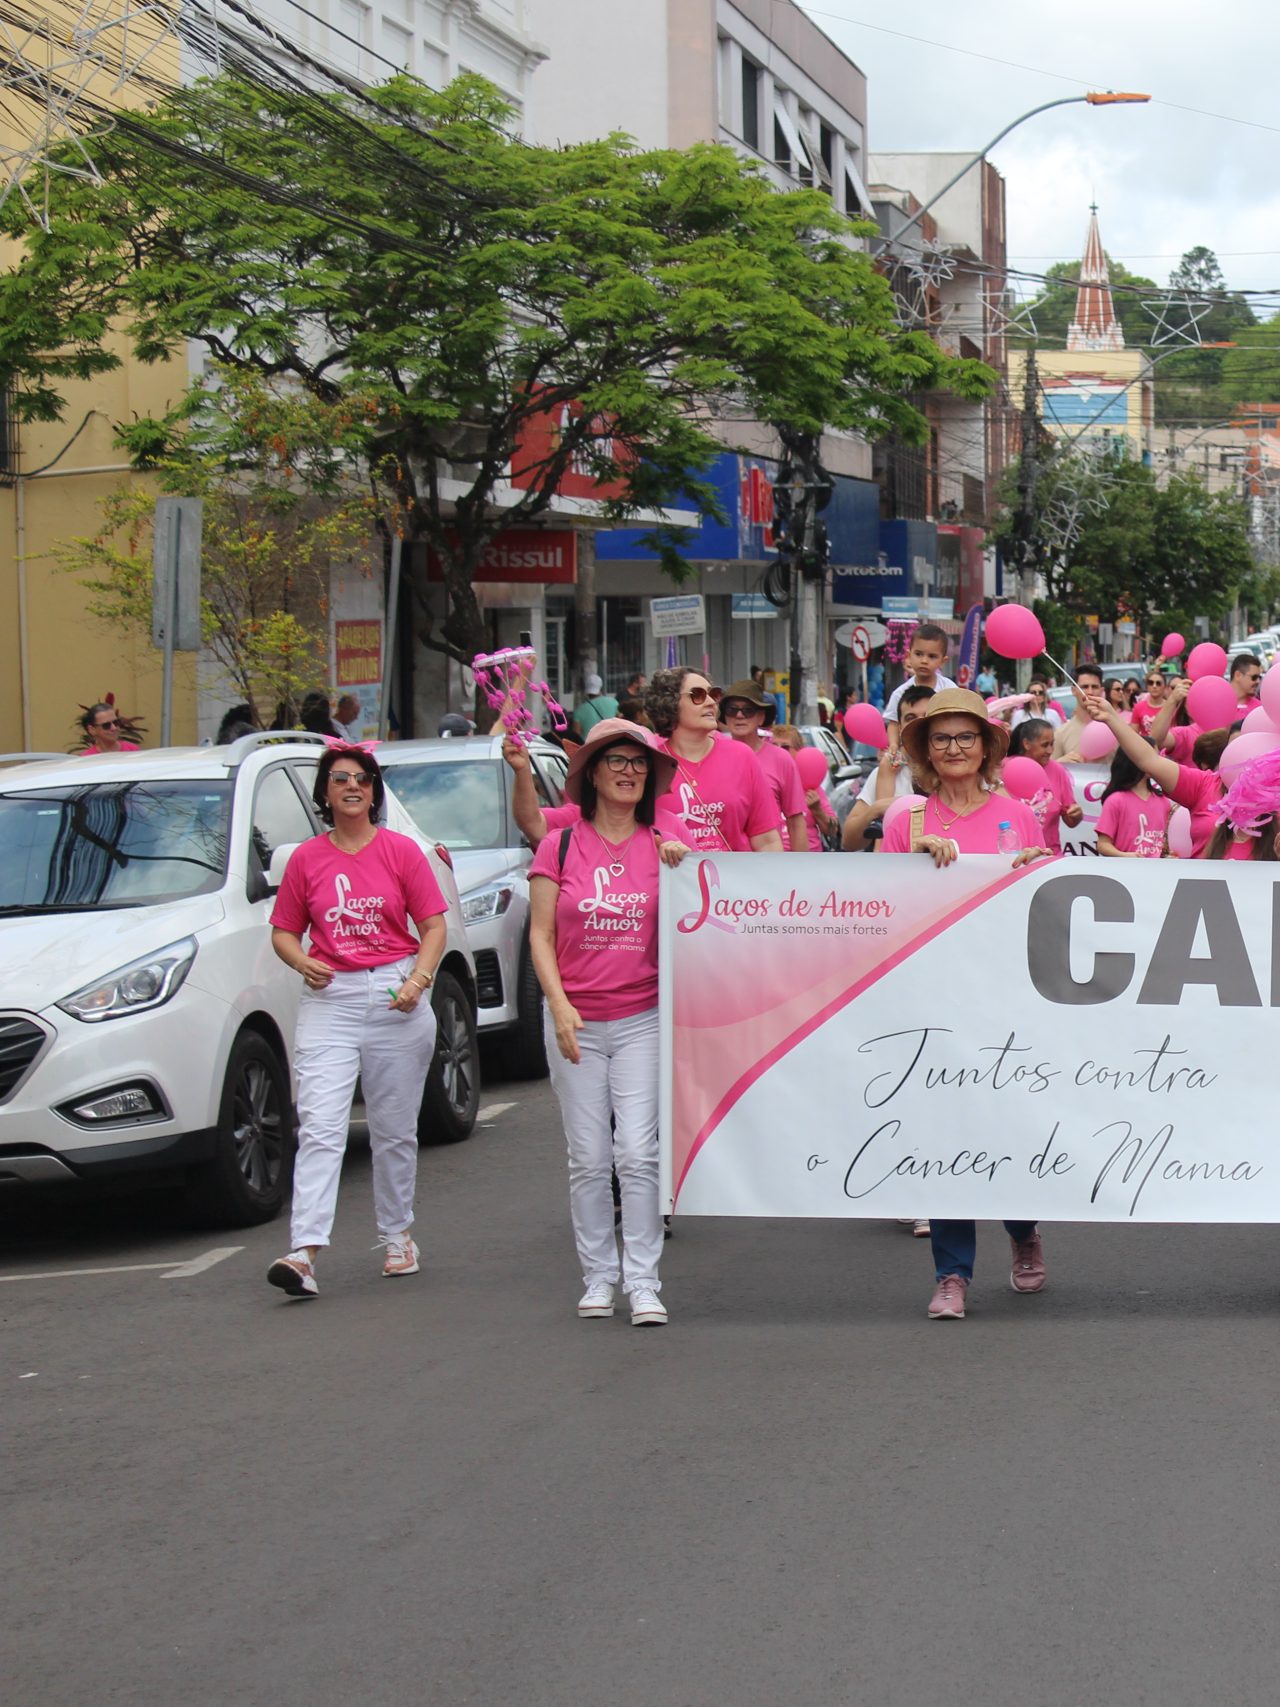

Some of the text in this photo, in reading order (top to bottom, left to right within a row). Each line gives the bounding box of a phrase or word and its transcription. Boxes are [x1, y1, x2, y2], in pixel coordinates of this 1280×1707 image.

[477, 546, 563, 568] Rissul
[676, 782, 726, 825] Laços
[325, 873, 386, 923] Laços
[577, 866, 650, 915] Laços
[676, 858, 896, 935] Laços de Amor
[365, 908, 384, 923] de
[583, 911, 643, 932] Amor
[626, 904, 646, 919] de
[332, 919, 381, 939] Amor
[740, 922, 888, 937] Juntas somos mais fortes
[608, 943, 619, 951] de
[620, 945, 646, 953] mama
[610, 936, 635, 944] contra
[857, 1028, 1218, 1109] Juntos contra
[806, 1153, 828, 1173] o
[1028, 1121, 1076, 1180] de
[1090, 1120, 1264, 1217] Mama
